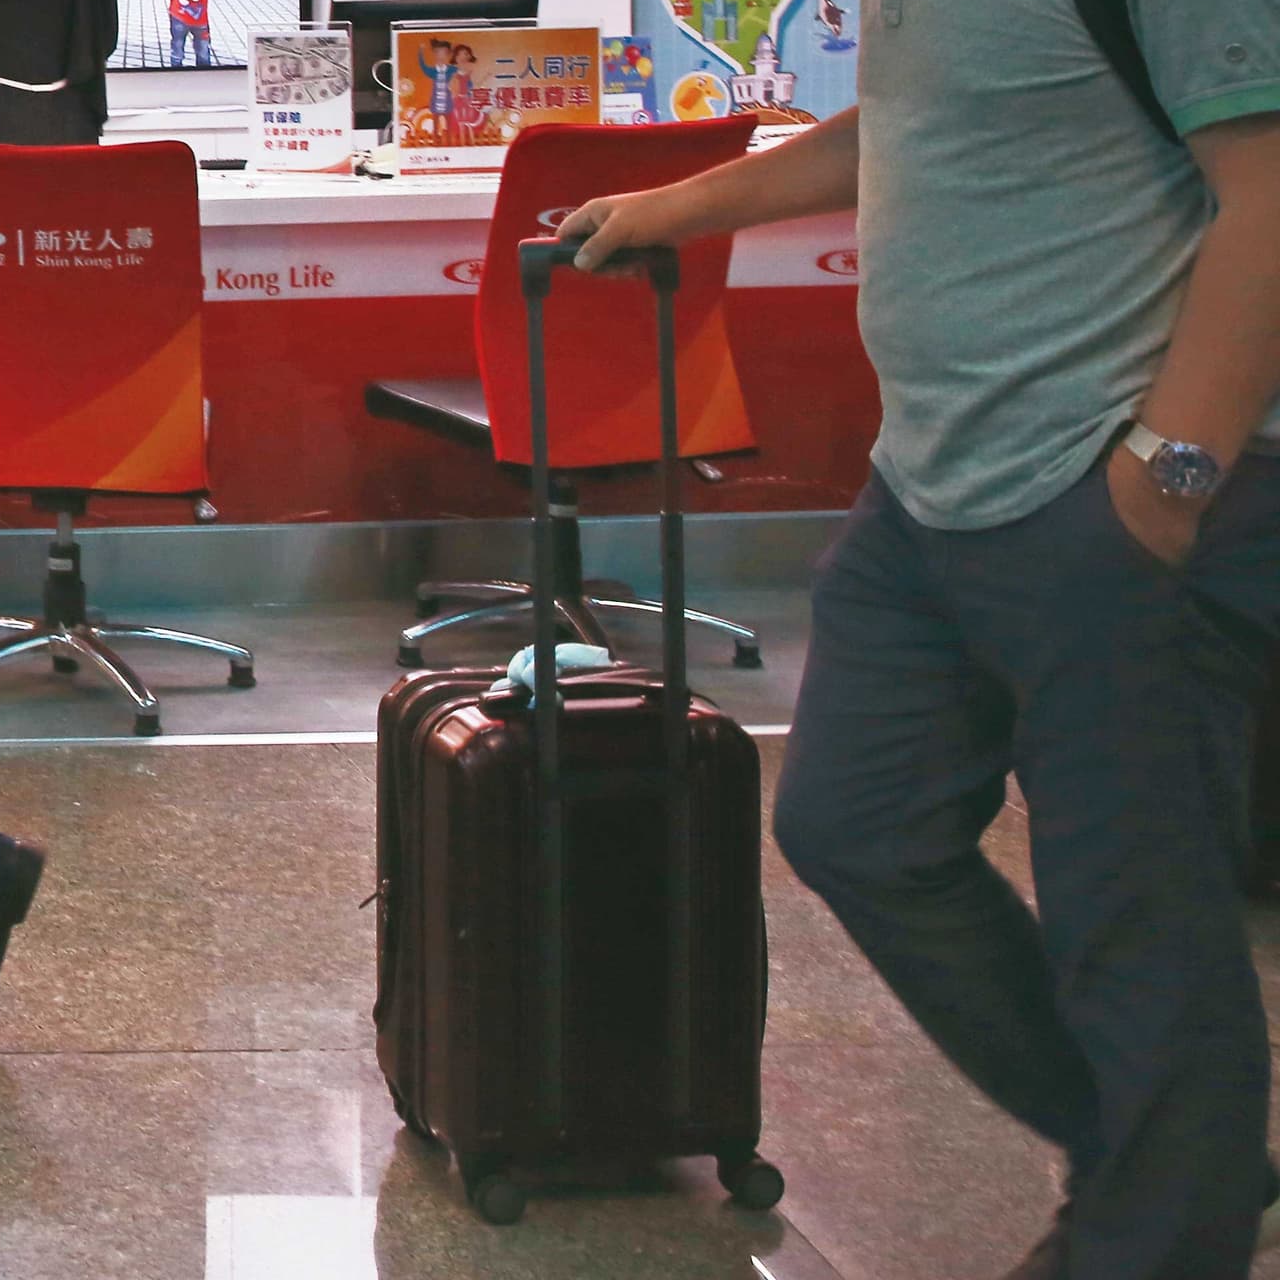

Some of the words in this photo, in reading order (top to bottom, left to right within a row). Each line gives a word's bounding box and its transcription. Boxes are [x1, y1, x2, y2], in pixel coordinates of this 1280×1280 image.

[495, 56, 591, 80] 二人同行
[471, 86, 591, 110] 享優惠費率
[34, 227, 154, 252] 新光人壽
[35, 255, 70, 267] Shin
[74, 255, 114, 270] Kong
[117, 253, 144, 266] Life
[215, 267, 281, 296] Kong
[290, 265, 336, 289] Life
